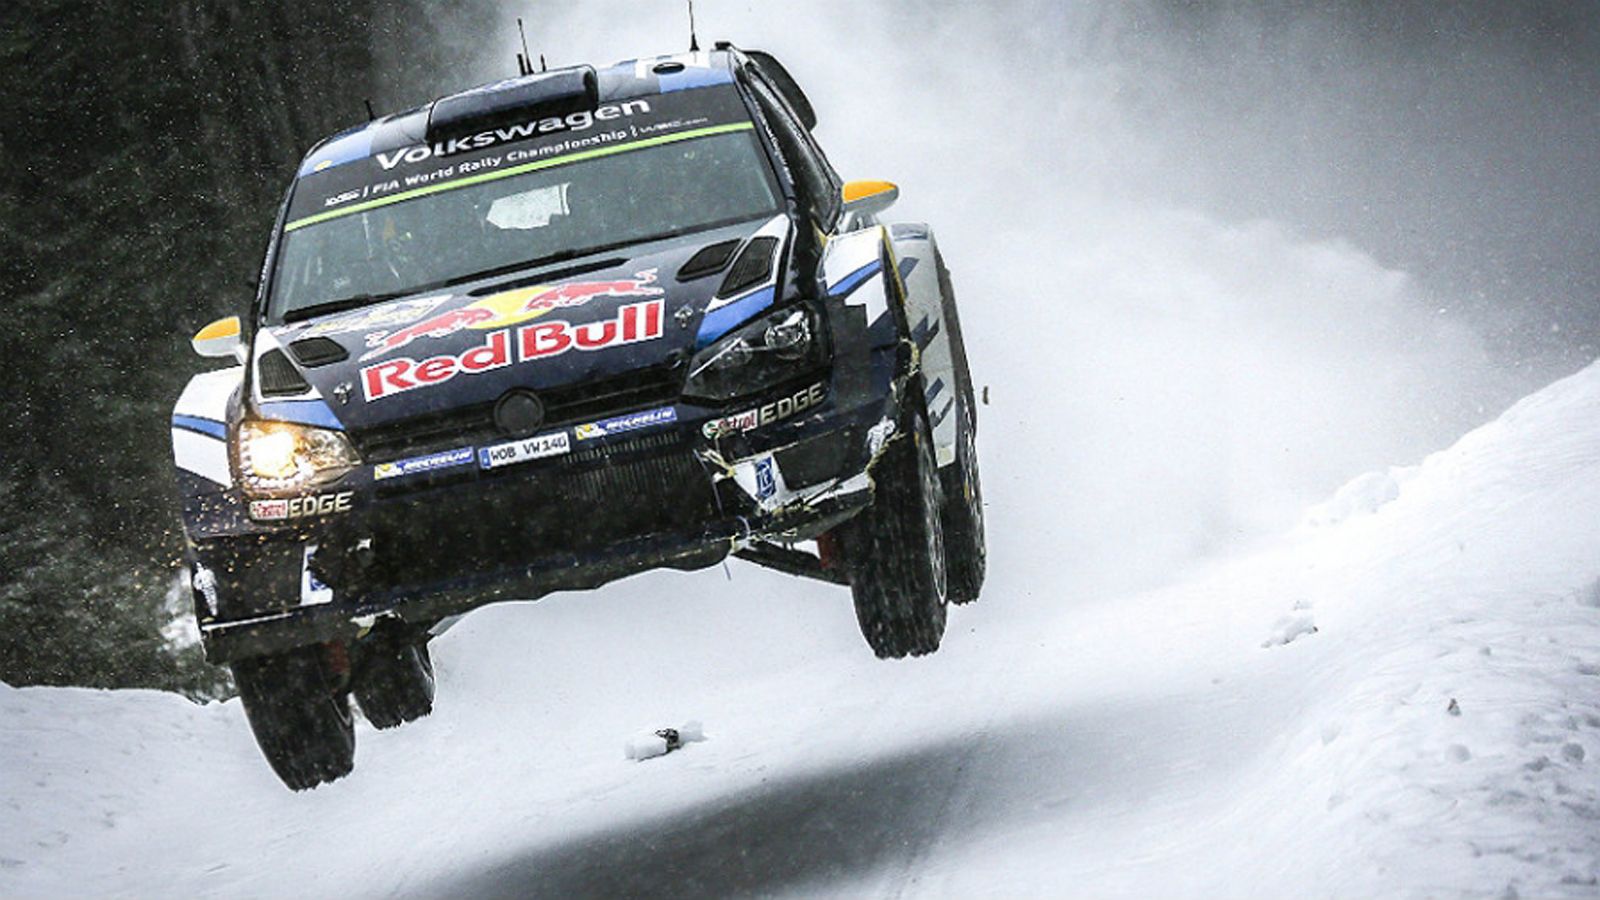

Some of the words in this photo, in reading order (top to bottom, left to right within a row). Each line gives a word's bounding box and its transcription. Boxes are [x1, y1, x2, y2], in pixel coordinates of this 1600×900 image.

[375, 99, 651, 170] Volkswagen
[372, 180, 400, 194] FIA
[405, 166, 454, 186] World
[459, 155, 502, 173] Rally
[506, 130, 627, 162] Championship
[362, 330, 510, 400] Red
[520, 300, 663, 361] Bull
[761, 382, 824, 425] EDGE
[491, 446, 516, 460] WOB
[289, 491, 354, 519] EDGE
